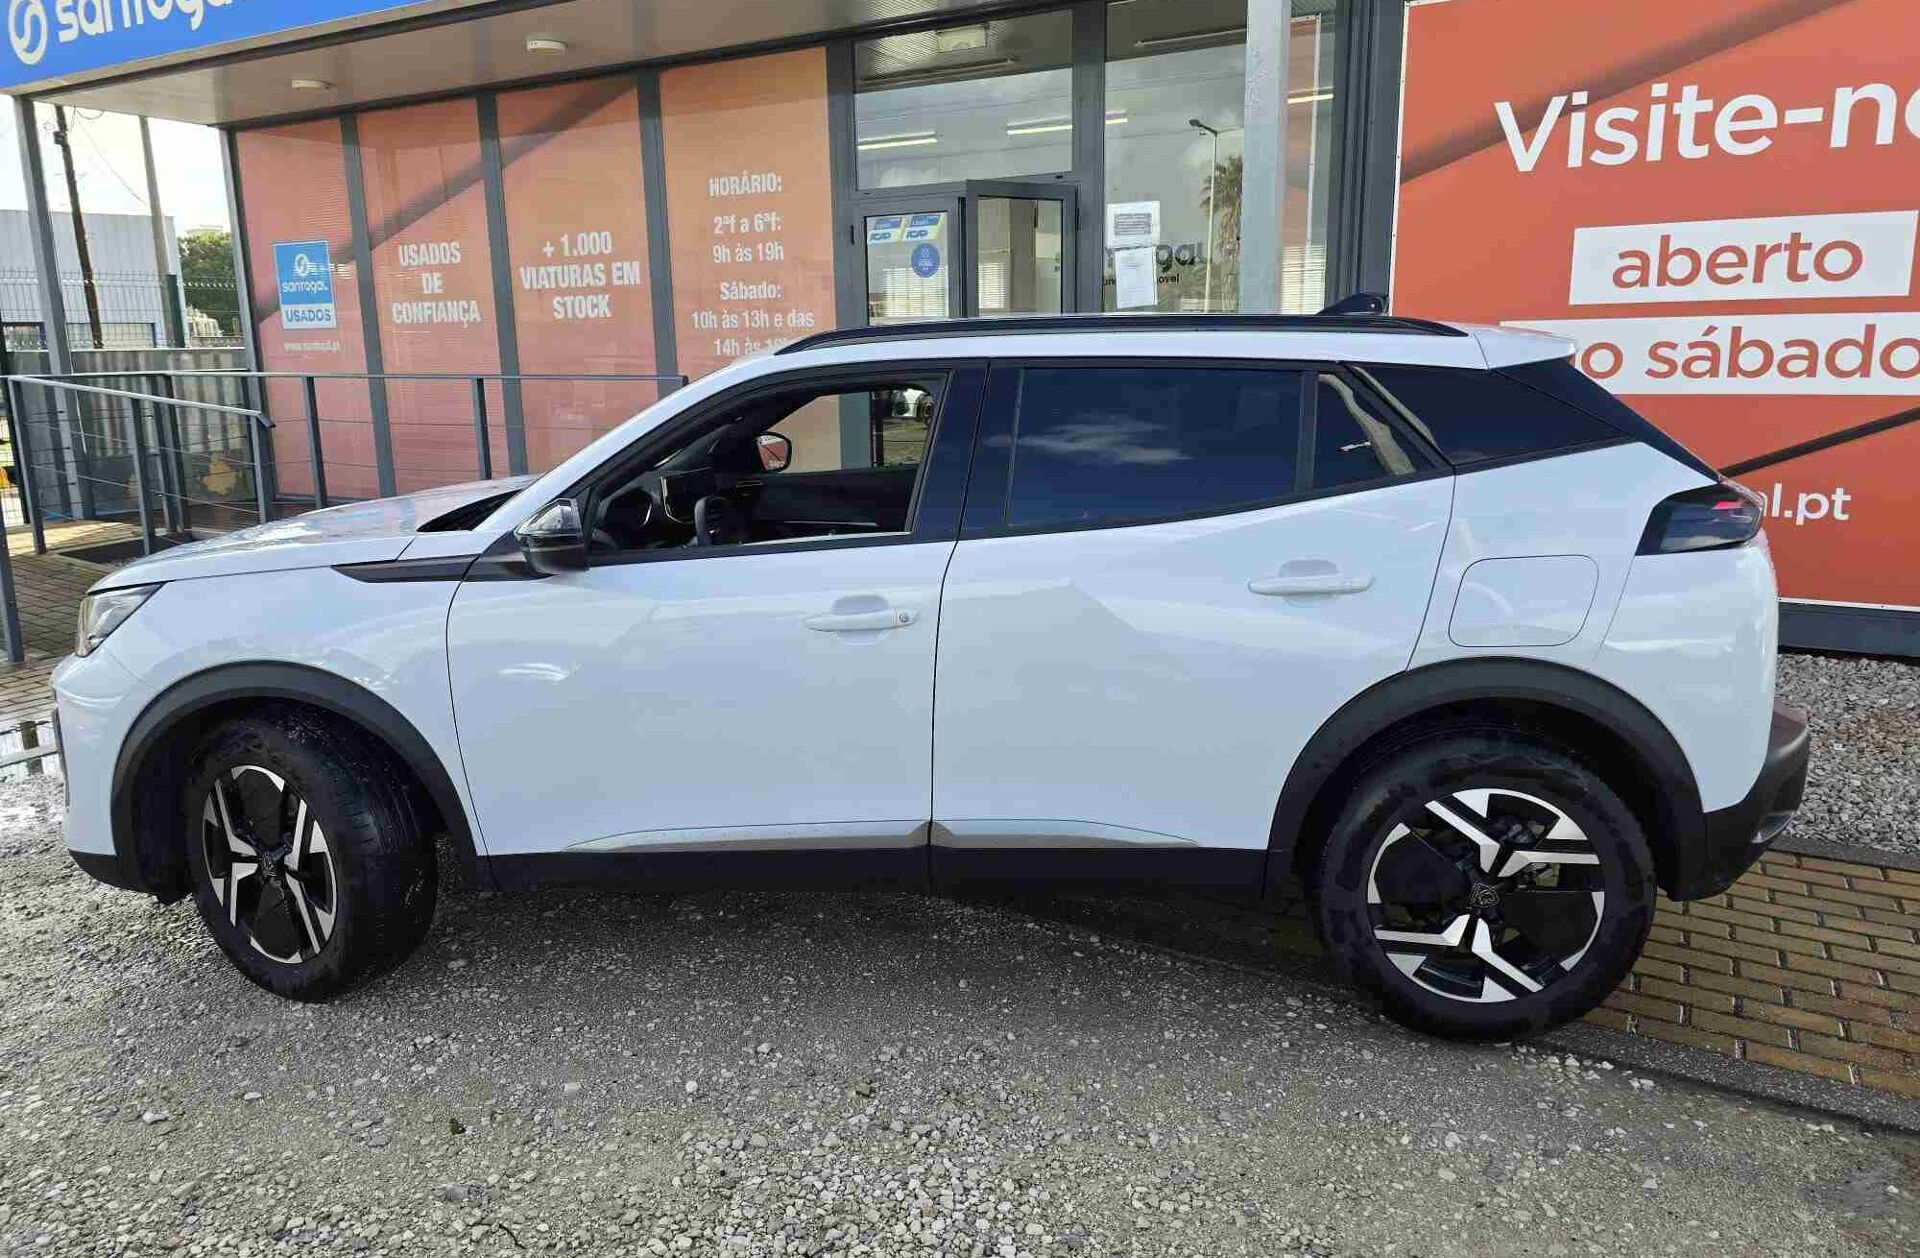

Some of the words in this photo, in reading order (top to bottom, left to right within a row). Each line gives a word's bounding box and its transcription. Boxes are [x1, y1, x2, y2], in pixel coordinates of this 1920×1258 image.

[1494, 82, 1920, 172] Visite-n
[708, 170, 782, 197] HORÁRIO:
[740, 216, 749, 233] a
[398, 241, 462, 267] USADOS
[542, 241, 555, 258] +
[560, 231, 612, 257] 1.000
[712, 243, 731, 263] 9h
[757, 240, 784, 261] 19h
[1612, 232, 1863, 289] aberto
[421, 272, 444, 294] DE
[519, 263, 606, 290] VIATURAS
[612, 260, 641, 287] EM
[720, 280, 782, 300] Sábado:
[286, 309, 331, 323] USADOS
[391, 300, 482, 328] CONFIANÇA
[553, 294, 612, 320] STOCK
[691, 308, 717, 329] 10h
[721, 308, 738, 329] às
[742, 308, 769, 328] 13h
[774, 312, 783, 328] e
[787, 308, 815, 328] das
[713, 338, 740, 356] 14h
[1569, 341, 1624, 379] o
[1645, 324, 1920, 379] sábado
